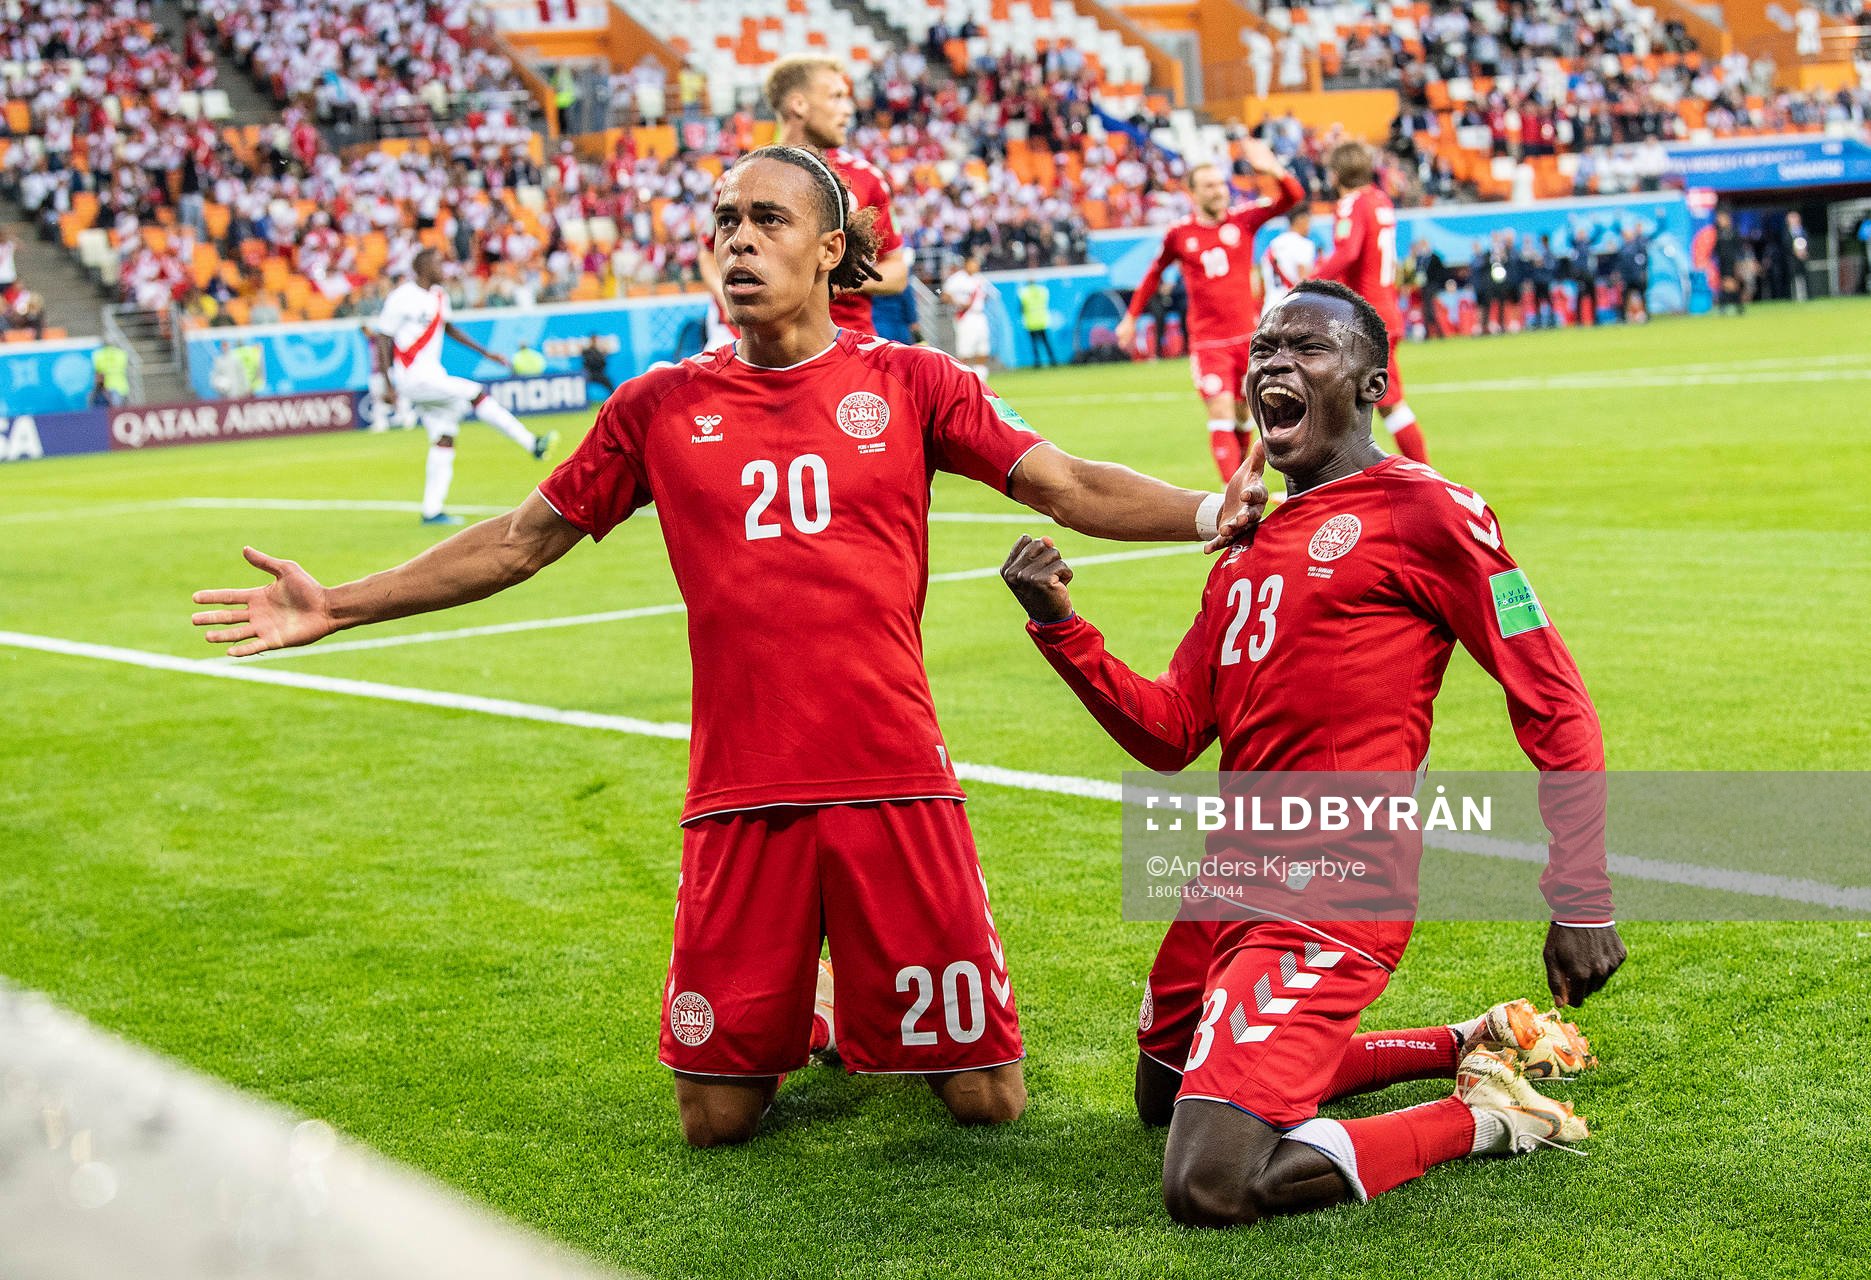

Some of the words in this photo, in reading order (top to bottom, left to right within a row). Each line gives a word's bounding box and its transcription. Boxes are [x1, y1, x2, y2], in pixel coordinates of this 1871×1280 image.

[112, 406, 219, 447] QATAR
[222, 395, 352, 434] AIRWAYS
[691, 433, 723, 443] hummel
[849, 407, 879, 422] DBU
[741, 454, 831, 540] 20
[1220, 574, 1284, 666] 23
[680, 1010, 704, 1026] DBU
[896, 961, 985, 1046] 20
[1184, 988, 1228, 1072] 3
[1365, 1039, 1437, 1051] DANMARK
